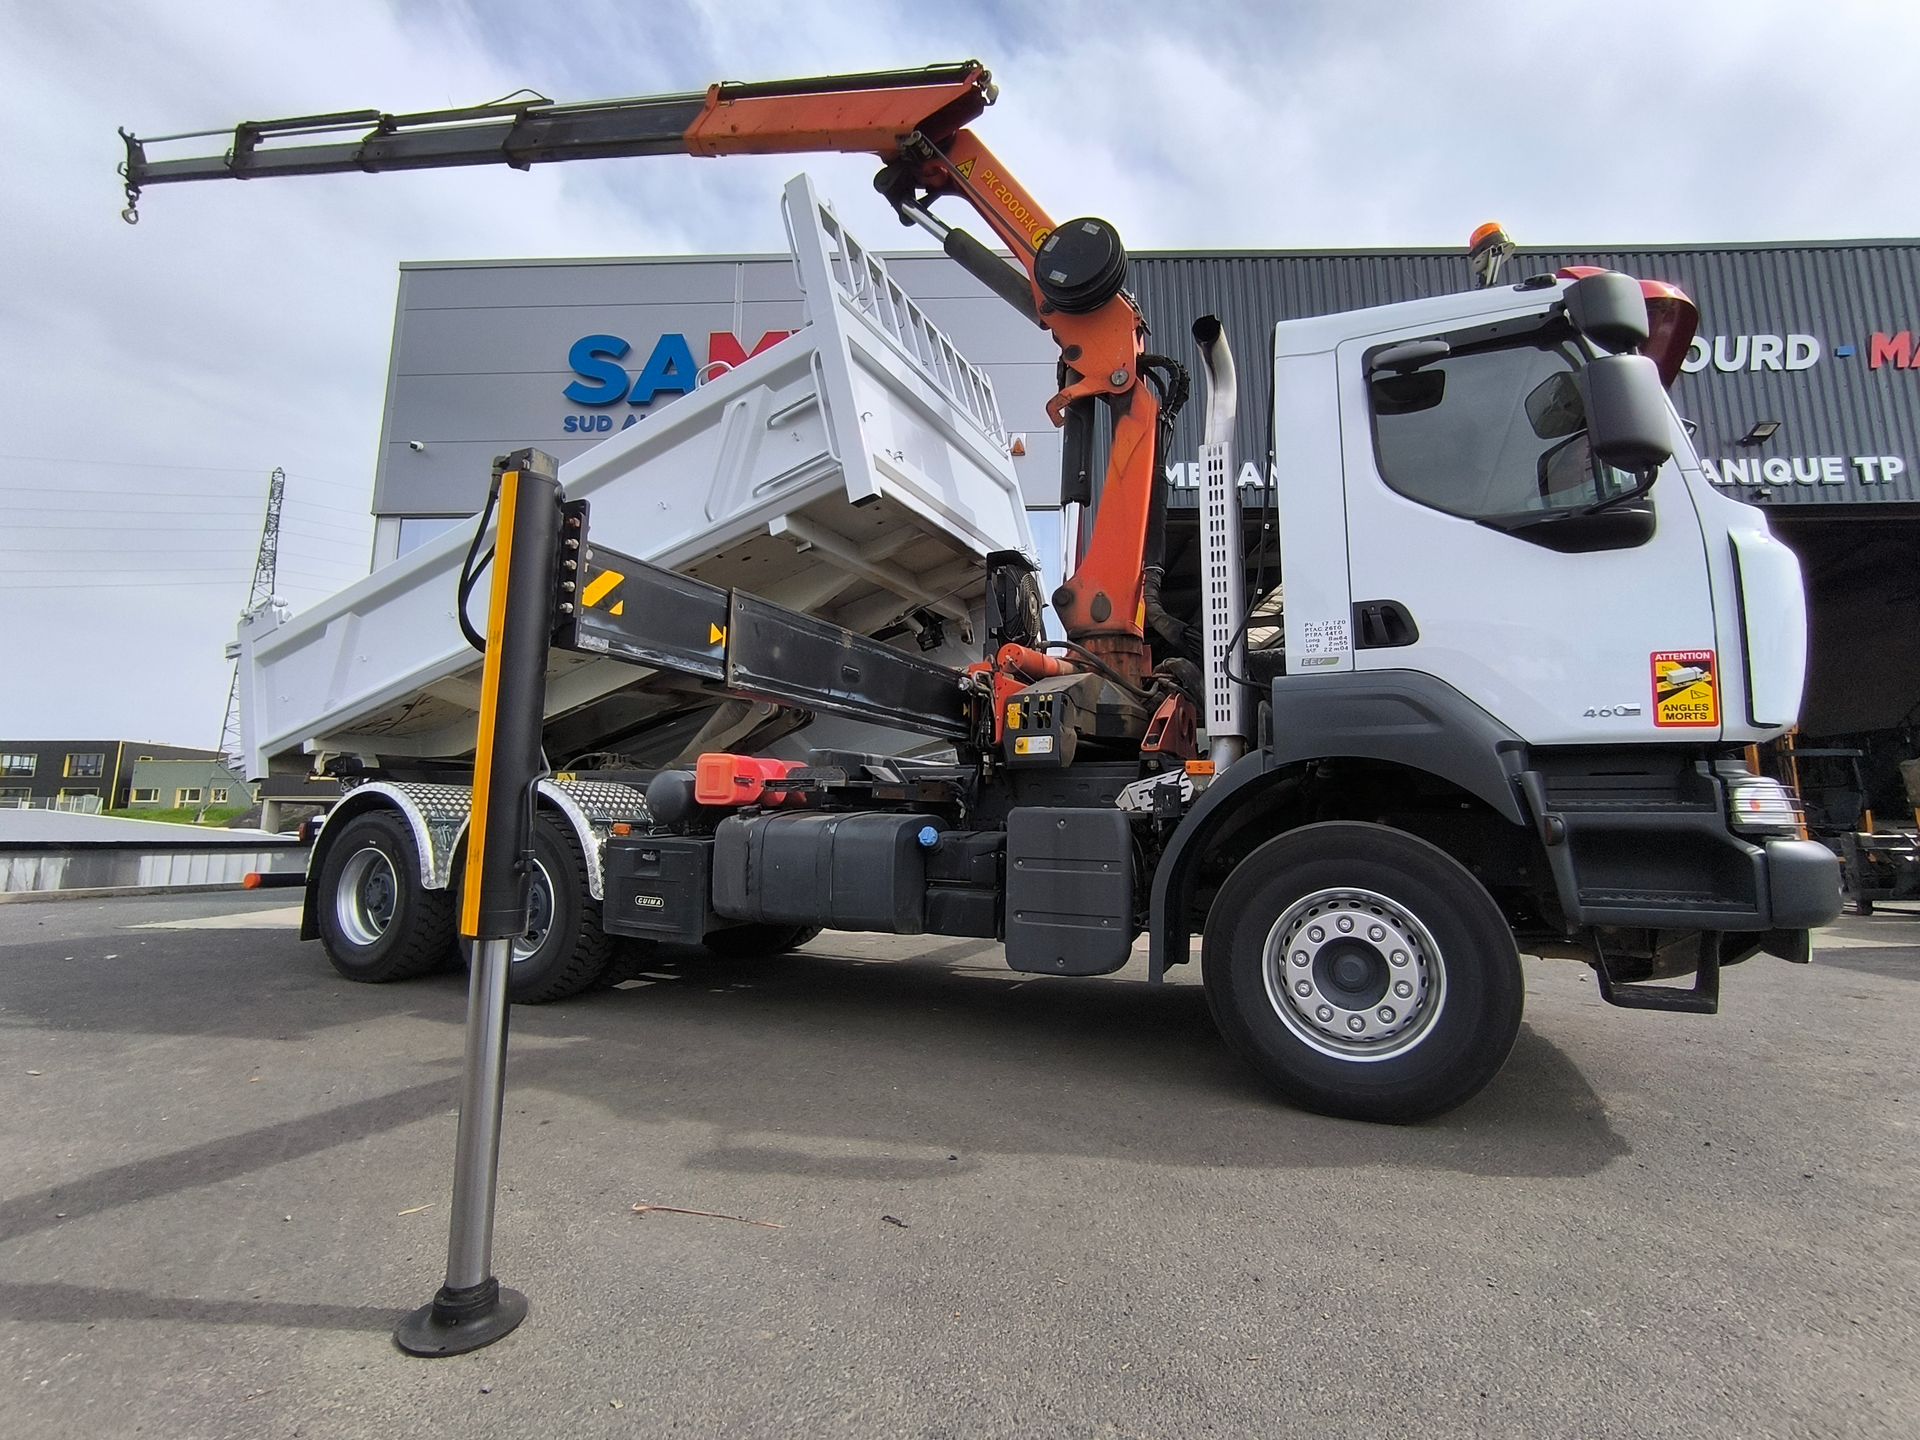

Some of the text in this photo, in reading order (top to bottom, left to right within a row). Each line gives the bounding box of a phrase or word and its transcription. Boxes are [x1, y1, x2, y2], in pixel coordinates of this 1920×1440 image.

[980, 169, 999, 190] PK
[1679, 334, 1820, 373] OURD
[1868, 331, 1920, 370] M
[563, 414, 613, 433] SUD
[1700, 456, 1904, 485] ANIQUE TP
[1655, 651, 1711, 661] ATTENTION
[1663, 703, 1709, 712] ANGLES
[1665, 712, 1708, 721] MORTS
